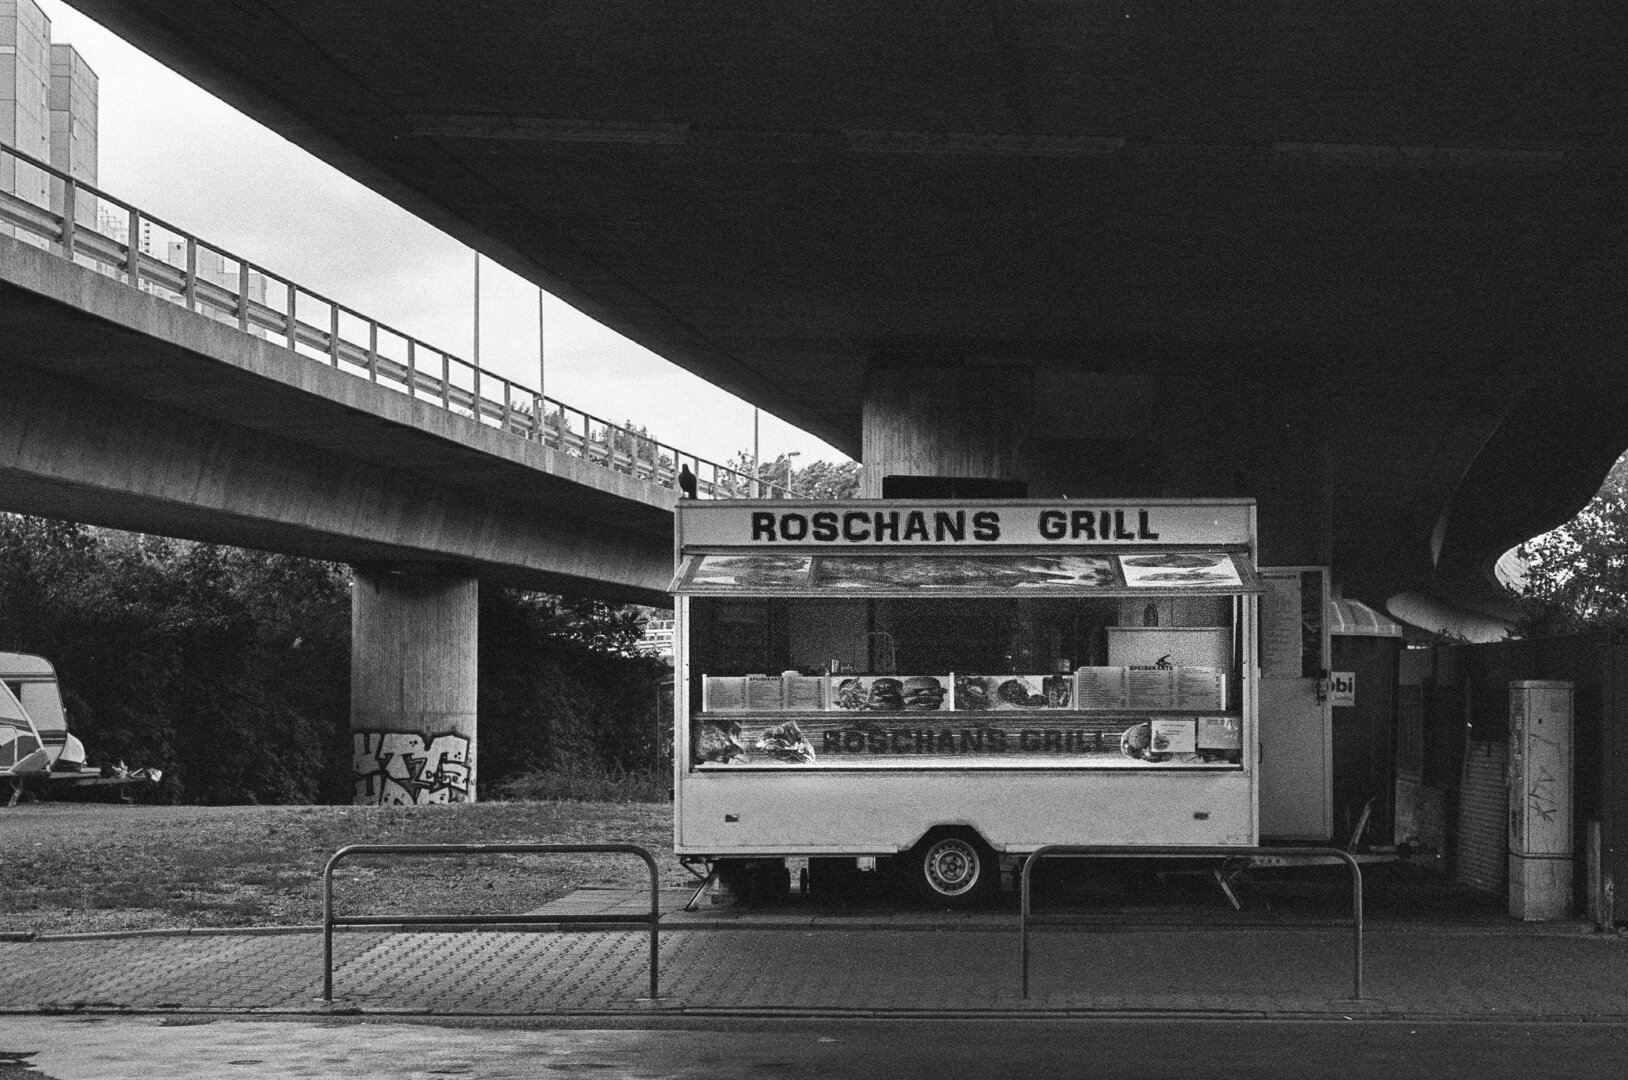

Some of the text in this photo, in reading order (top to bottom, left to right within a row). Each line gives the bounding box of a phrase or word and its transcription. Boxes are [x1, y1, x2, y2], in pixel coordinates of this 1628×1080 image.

[751, 509, 1160, 543] ROSCHANS GRILL
[822, 729, 1110, 753] ROSCHANS GRILL
